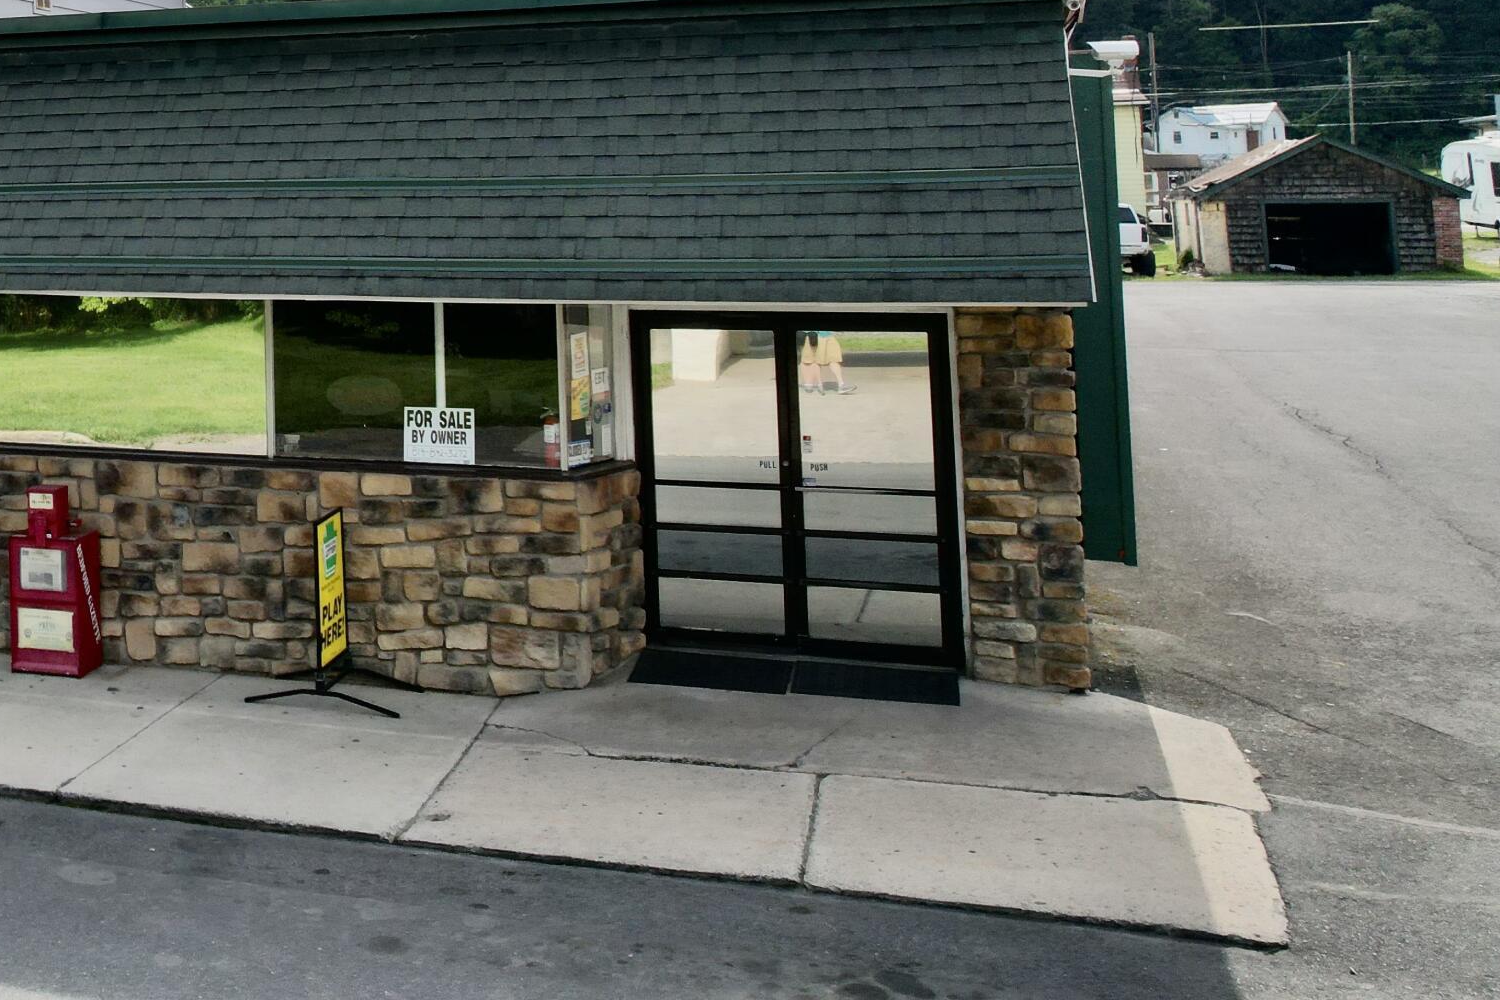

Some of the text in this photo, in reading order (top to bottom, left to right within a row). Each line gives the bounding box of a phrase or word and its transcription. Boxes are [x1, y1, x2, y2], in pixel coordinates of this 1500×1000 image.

[407, 410, 472, 430] FOR SALE
[412, 430, 467, 445] BY OWNER
[760, 461, 777, 469] PULL
[810, 464, 828, 472] PUSH
[76, 543, 102, 645] BEDFORD GAZETTE
[322, 592, 342, 626] PLAY
